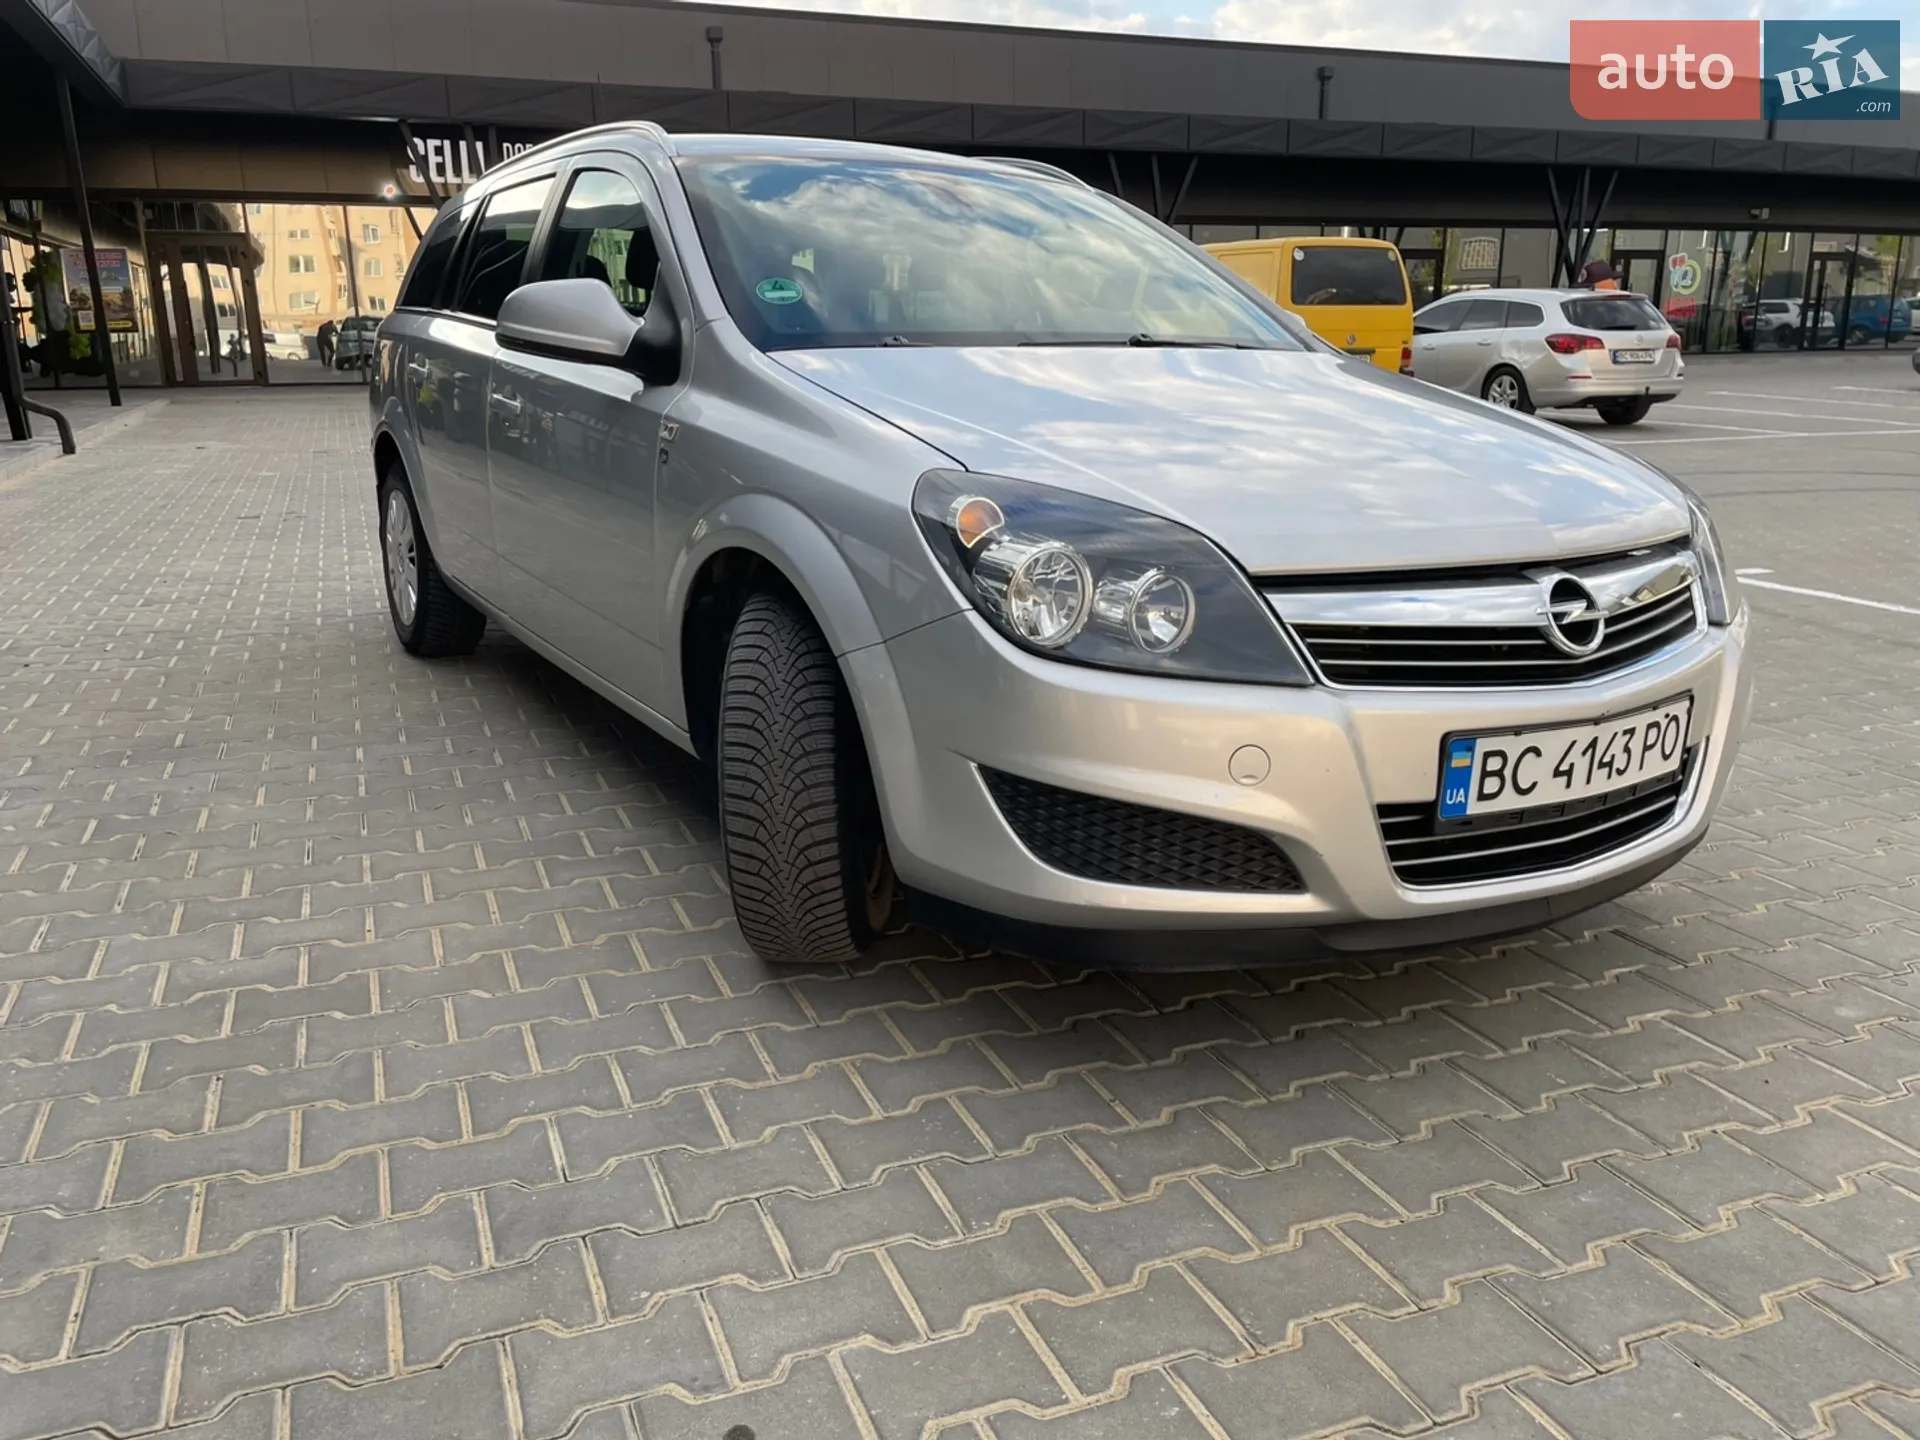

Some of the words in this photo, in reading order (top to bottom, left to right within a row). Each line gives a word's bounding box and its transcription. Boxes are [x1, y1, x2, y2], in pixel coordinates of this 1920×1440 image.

[1476, 745, 1543, 802] BC
[1552, 726, 1637, 790] 4143
[1638, 712, 1681, 771] PO
[1445, 787, 1466, 806] UA
